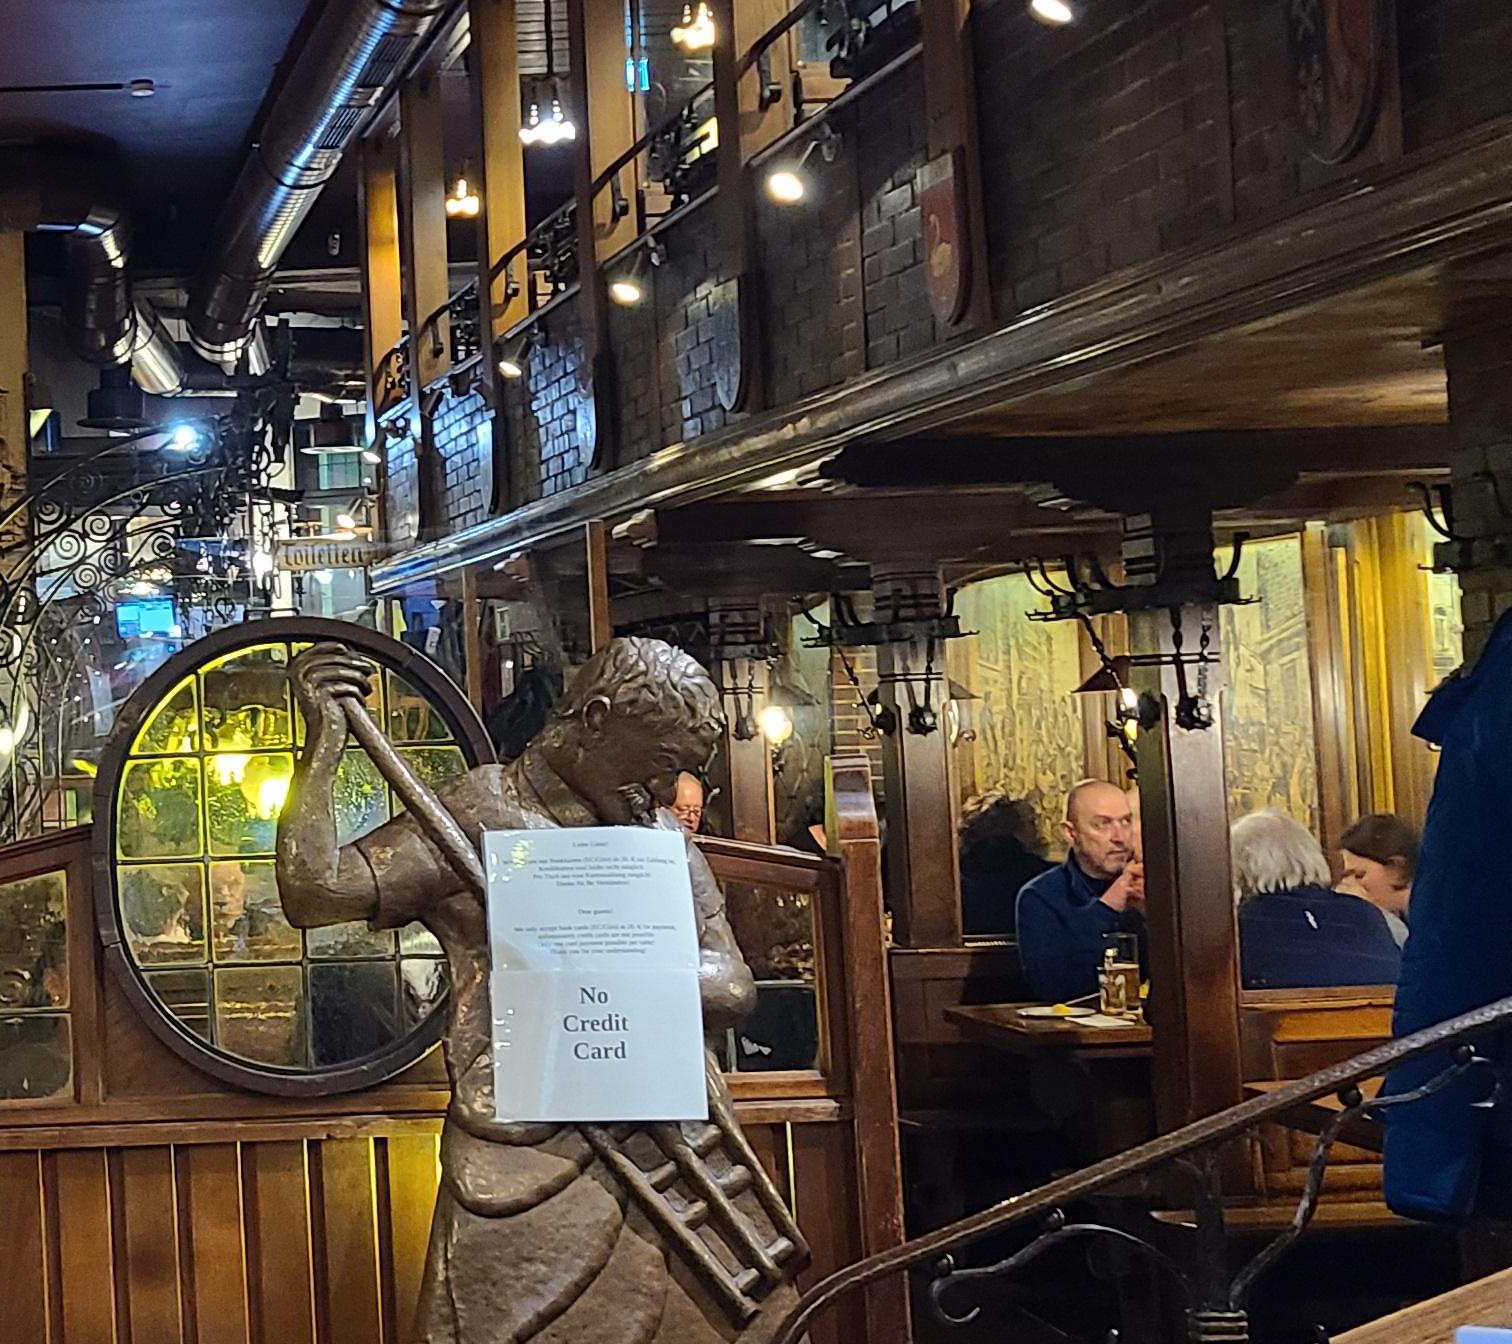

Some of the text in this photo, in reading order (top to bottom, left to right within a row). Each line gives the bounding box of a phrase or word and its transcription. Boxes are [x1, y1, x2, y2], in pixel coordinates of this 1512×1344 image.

[579, 986, 609, 1005] No
[562, 1013, 630, 1033] Credit
[573, 1040, 627, 1061] Card
